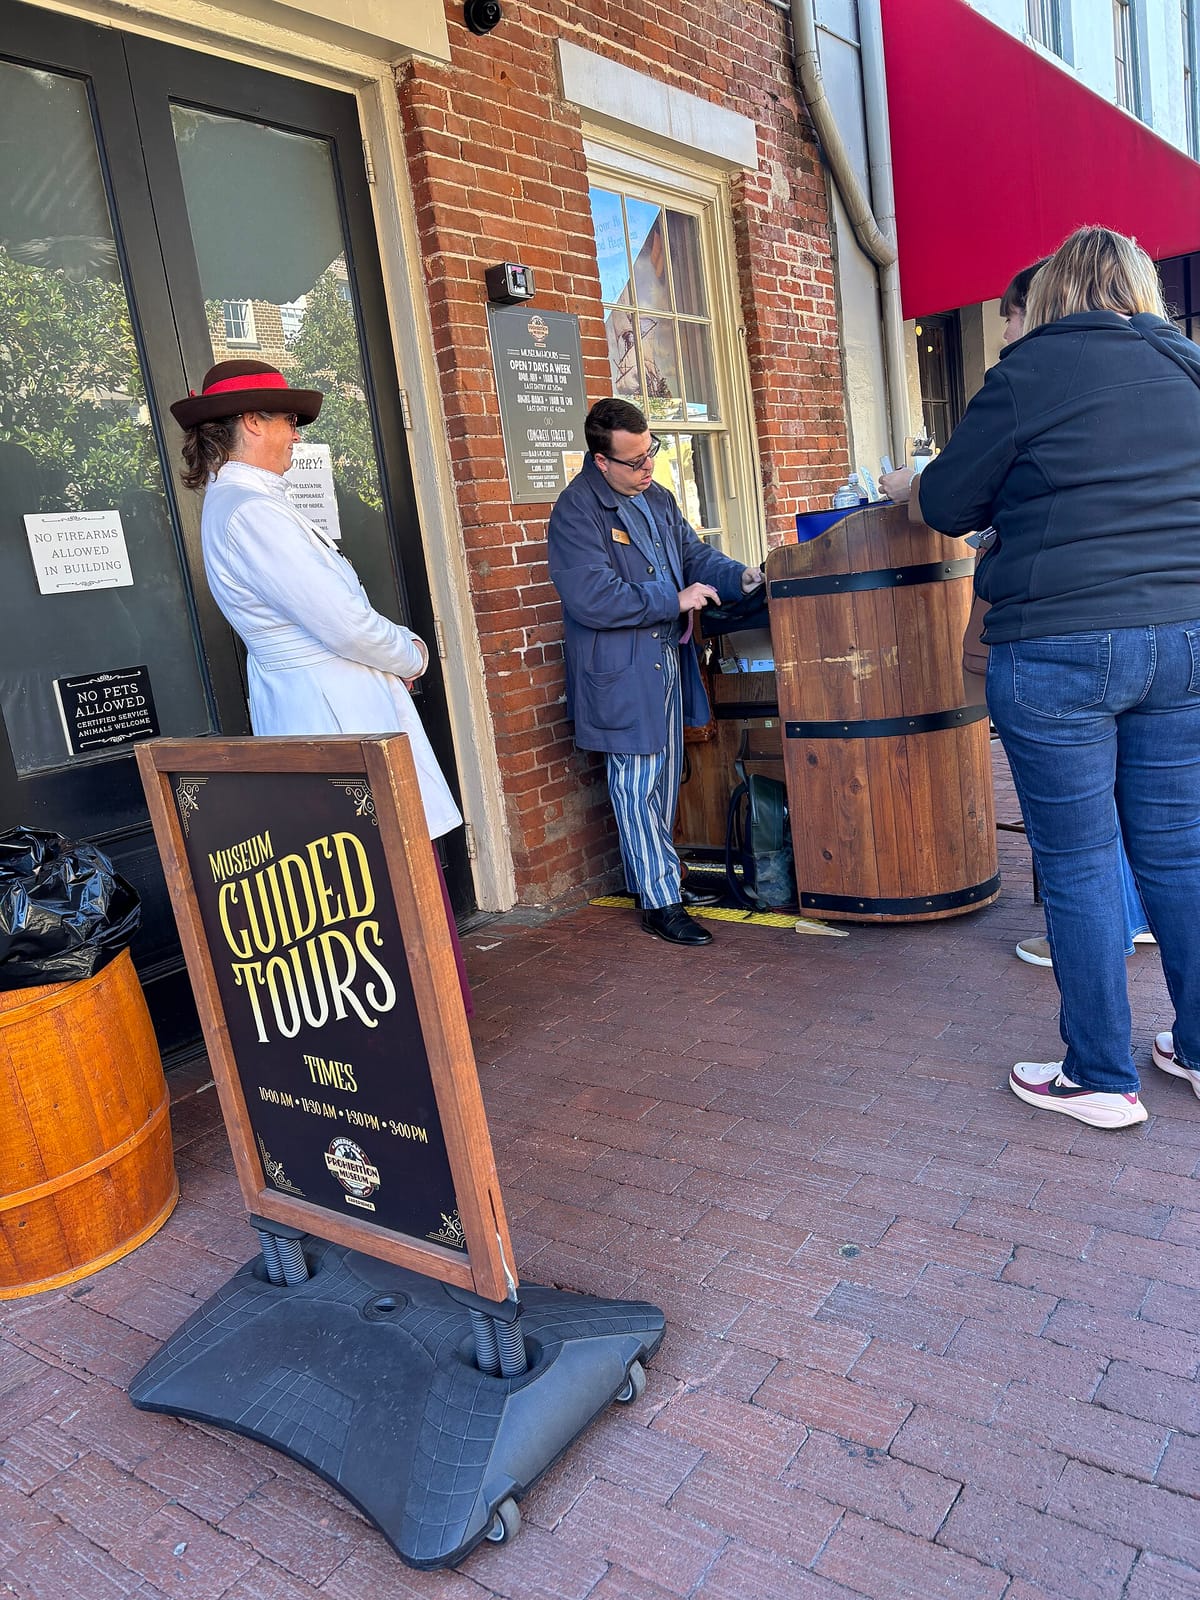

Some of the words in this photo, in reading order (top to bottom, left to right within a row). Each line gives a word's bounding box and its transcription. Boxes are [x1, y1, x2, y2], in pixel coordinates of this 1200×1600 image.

[509, 359, 528, 371] OPEN
[527, 361, 532, 371] 7
[533, 361, 549, 373] DAYS
[549, 362, 555, 373] A
[554, 363, 572, 375] WEEK
[292, 457, 323, 469] ORRY!
[34, 533, 52, 544] NO
[57, 528, 119, 543] FIREARMS
[51, 545, 110, 559] ALLOWED
[44, 565, 58, 576] IN
[63, 560, 122, 575] BUILDING
[76, 690, 98, 704] NO
[103, 683, 139, 699] PETS
[75, 695, 146, 719] ALLOWED
[76, 716, 117, 729] CERTIFIED
[118, 709, 149, 722] SERVICE
[78, 727, 112, 738] ANIMALS
[114, 717, 151, 731] WELCOME
[208, 830, 275, 883] MUSEUM
[218, 831, 376, 959] GUIDED
[231, 920, 397, 1043] TOURS
[303, 1054, 358, 1093] TIMES
[258, 1086, 280, 1104] 10:00
[280, 1091, 294, 1108] AM
[300, 1097, 322, 1116] 11:30
[322, 1102, 338, 1120] AM
[345, 1108, 364, 1127] 1:30
[363, 1113, 380, 1131] PM
[388, 1119, 411, 1139] 3:00
[410, 1125, 429, 1144] PM
[326, 1156, 379, 1178] PROHIBITION
[339, 1169, 369, 1184] MUSEUM
